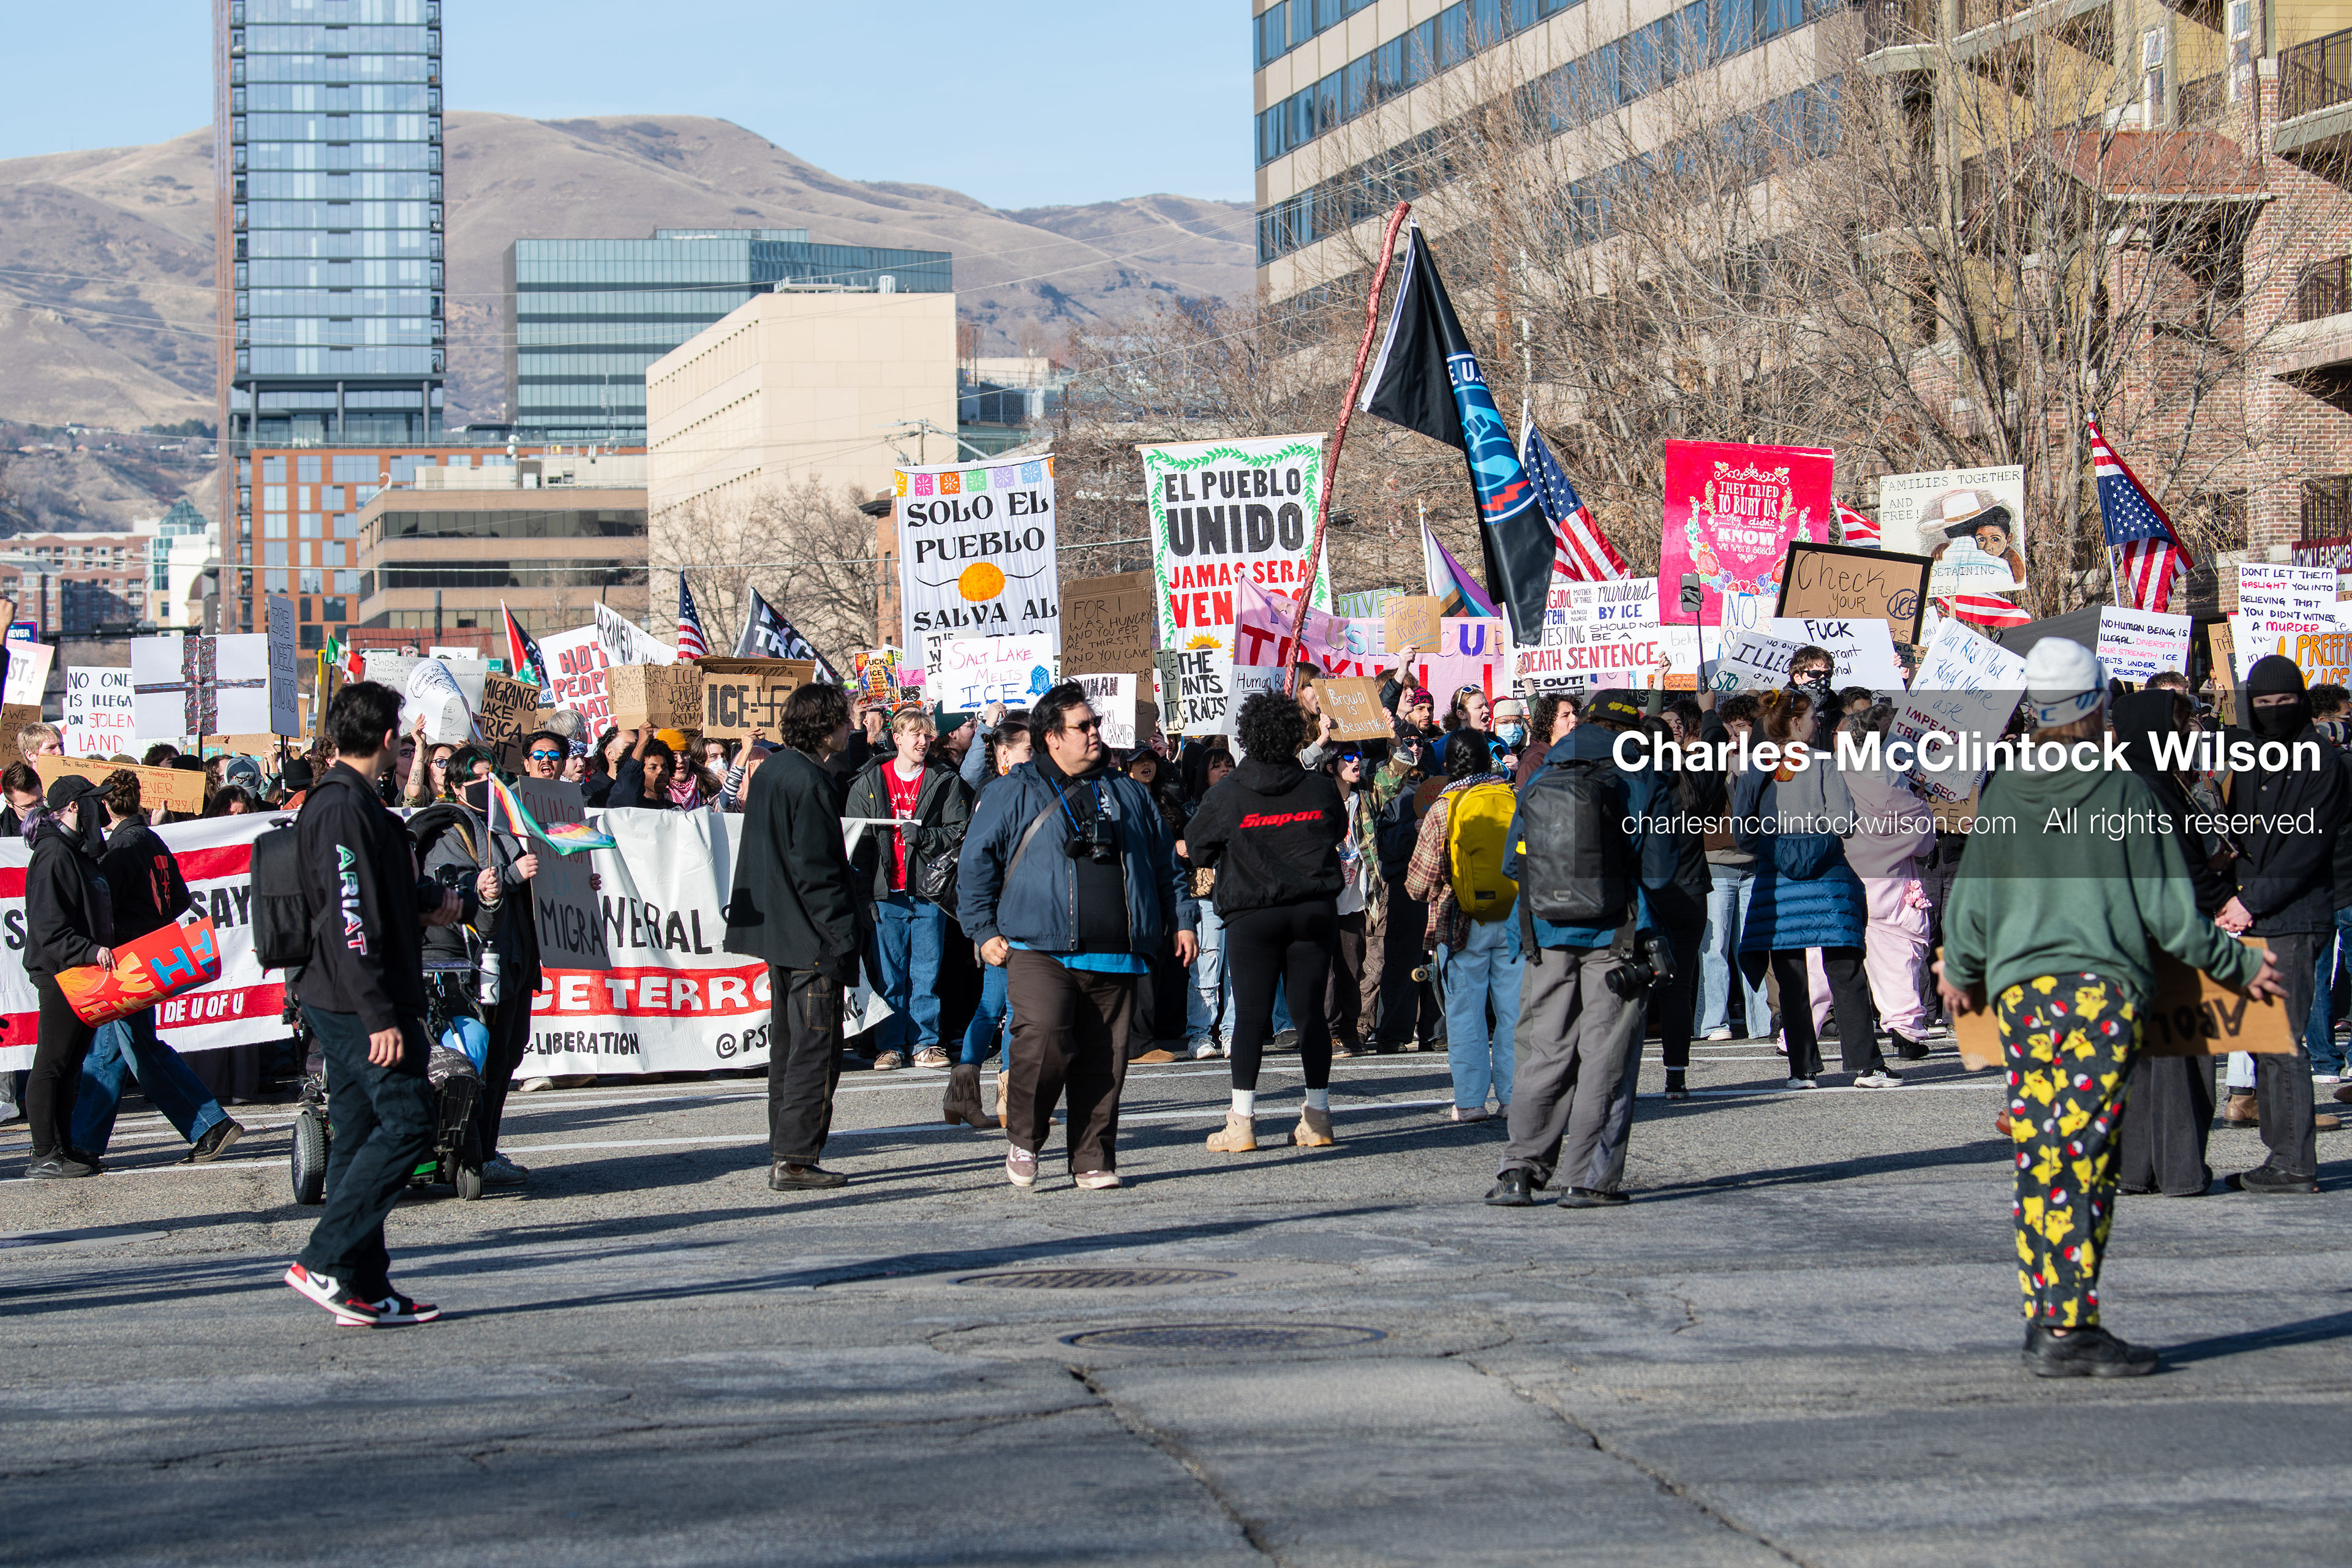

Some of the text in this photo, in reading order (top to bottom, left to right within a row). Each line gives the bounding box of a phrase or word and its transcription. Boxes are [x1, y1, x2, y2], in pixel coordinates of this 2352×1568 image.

[1164, 468, 1301, 502] EL PUEBLO
[1719, 481, 1779, 498] THEY TRIED
[1880, 470, 2021, 492] FAMILIES TOGETHER
[907, 491, 1049, 527] SOLO EL
[1718, 494, 1762, 516] TO BURY
[1889, 497, 1913, 509] AND
[1727, 513, 1742, 529] they
[1882, 509, 1920, 522] FREE!
[1166, 502, 1304, 557] UNIDO
[1717, 528, 1777, 546] KNOW
[915, 527, 1045, 564] PUEBLO
[1752, 545, 1776, 556] seeds
[2293, 544, 2351, 570] NOW LEASING
[1169, 562, 1246, 589] JAMAS
[1798, 551, 1888, 598] Check
[2274, 569, 2294, 579] LET
[2299, 571, 2333, 580] THEM
[1599, 580, 1657, 603] murdered
[2242, 581, 2288, 590] GASLIGHT
[1074, 600, 1109, 620] FOR
[1727, 593, 1758, 630] NO
[2241, 595, 2321, 608] BELIEVING THAT
[914, 598, 1058, 632] SALVA AL
[1599, 604, 1643, 620] BY ICE
[2244, 607, 2264, 617] YOU
[271, 607, 290, 639] ICE
[1069, 620, 1104, 632] WAS
[1589, 622, 1637, 633] SHOULD
[1804, 619, 1855, 642] FUCK
[2101, 619, 2188, 638] NO HUMAN BEING IS
[2252, 621, 2320, 633] A MURDER
[1066, 625, 1139, 645] AND YOU FED
[1592, 633, 1611, 641] BE
[2136, 638, 2177, 649] DIVERSITY
[273, 641, 294, 673] DEEZ
[558, 641, 609, 676] HOT
[996, 639, 1034, 663] LAKE
[1065, 648, 1149, 666] AND YOU GAVE
[1523, 641, 1659, 674] DEATH SENTENCE
[1732, 643, 1791, 674] ILLEG
[864, 658, 886, 666] FUCK
[1177, 650, 1214, 675] THE
[2097, 656, 2158, 670] MELTS UNDER
[69, 672, 133, 690] NO ONE
[974, 669, 1023, 685] MELTS
[1237, 673, 1272, 690] Human
[1544, 675, 1584, 687] OUT!
[1753, 673, 1774, 684] ON
[274, 676, 296, 713] NUTS
[552, 672, 608, 704] PEOP
[960, 683, 1027, 707] ICE
[1327, 688, 1366, 707] Brown
[69, 694, 134, 707] IS ILLEGA
[9, 709, 29, 720] WE
[69, 714, 83, 725] ON
[1337, 717, 1388, 734] Beautiful
[78, 733, 124, 753] LAND
[335, 843, 368, 956] ARIAT
[539, 896, 607, 957] MIGRA
[603, 895, 712, 954] NERAL
[164, 993, 244, 1023] DE U OF U
[536, 1031, 640, 1055] LIBERATION
[716, 1023, 771, 1059] @PS
